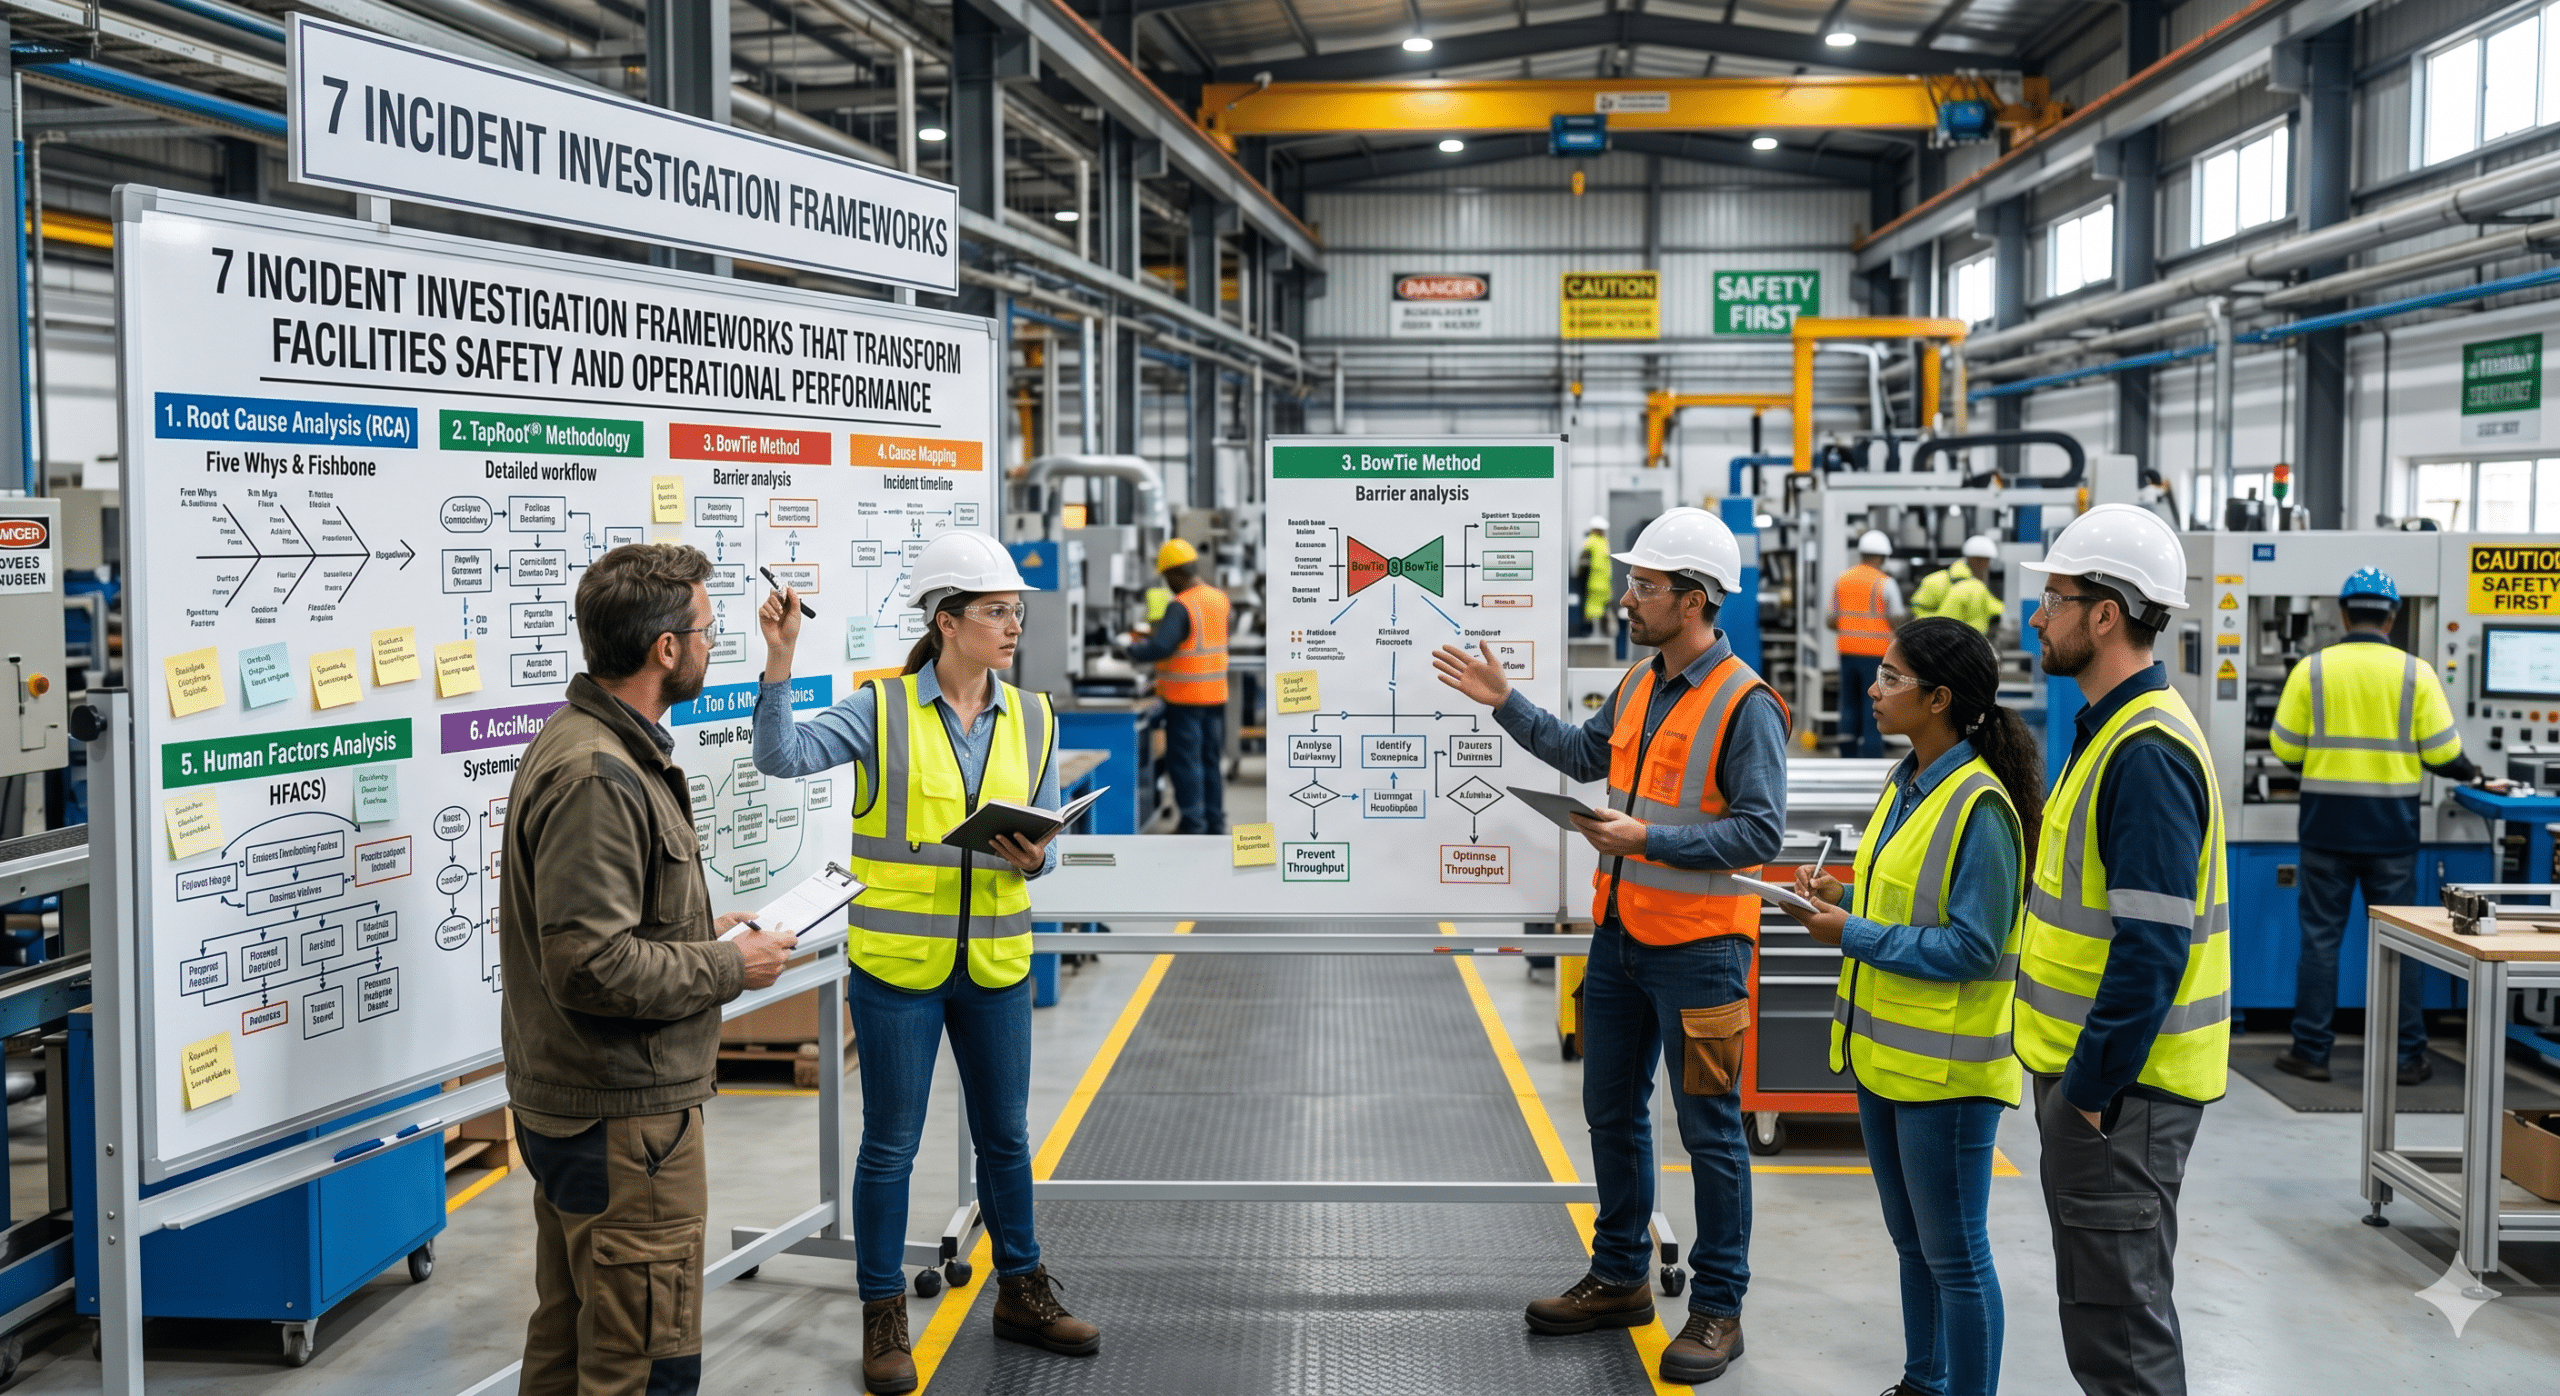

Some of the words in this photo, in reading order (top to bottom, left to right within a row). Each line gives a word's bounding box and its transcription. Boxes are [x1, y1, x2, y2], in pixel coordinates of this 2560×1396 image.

[322, 76, 349, 134] 7
[364, 85, 547, 176] INCIDENT
[558, 132, 781, 220] INVESTIGATION
[790, 184, 948, 259] FRAMEWORKS
[1567, 279, 1654, 297] CAUTION
[1717, 276, 1813, 301] SAFETY
[212, 247, 233, 293] 7
[248, 252, 407, 314] INCIDENT
[416, 275, 627, 335] INVESTIGATION
[636, 303, 793, 357] FRAMEWORKS
[800, 323, 848, 360] THAT
[855, 331, 961, 375] TRANSFORM
[1730, 304, 1801, 330] FIRST
[273, 319, 446, 376] FACILITIES
[456, 337, 563, 384] SAFETY
[571, 349, 624, 390] AND
[632, 357, 784, 402] OPERATIONAL
[793, 373, 931, 414] PERFORMANCE
[165, 403, 181, 427] 1.
[187, 405, 230, 430] Root
[234, 407, 287, 432] Cause
[292, 411, 361, 440] Analysis
[366, 414, 410, 443] (RCA)
[452, 420, 467, 440] 2.
[546, 425, 630, 453] Methodology
[704, 434, 714, 451] 3.
[716, 435, 757, 453] BowTie
[760, 437, 800, 456] Method
[206, 451, 240, 472] Five
[244, 452, 287, 478] Whys
[292, 454, 304, 475] &
[309, 455, 376, 476] Fishbone
[878, 446, 887, 460] 4.
[888, 445, 915, 462] Cause
[917, 448, 957, 467] Mapping
[1342, 454, 1356, 471] 3.
[1361, 454, 1418, 471] BowTie
[1422, 454, 1481, 471] Method
[485, 460, 538, 479] Detailed
[541, 463, 597, 482] workflow
[713, 468, 749, 486] Barrier
[751, 471, 791, 490] analysis
[884, 474, 918, 491] Incident
[920, 475, 953, 492] timeline
[1356, 485, 1407, 501] Barrier
[1410, 485, 1469, 505] analysis
[1405, 561, 1439, 572] BowTie
[2482, 577, 2560, 592] SAFETY
[2495, 595, 2552, 610] FIRST
[728, 692, 734, 710] 6
[470, 720, 483, 741] 6.
[700, 727, 734, 748] Simple
[182, 753, 198, 776] 5.
[204, 745, 263, 773] Human
[268, 738, 328, 767] Factors
[332, 731, 396, 760] Analysis
[1376, 740, 1412, 752] Identify
[270, 777, 326, 806] HFACS)
[1296, 849, 1335, 860] Prevent
[1287, 862, 1345, 875] Throughput
[1445, 864, 1504, 877] Throughput
